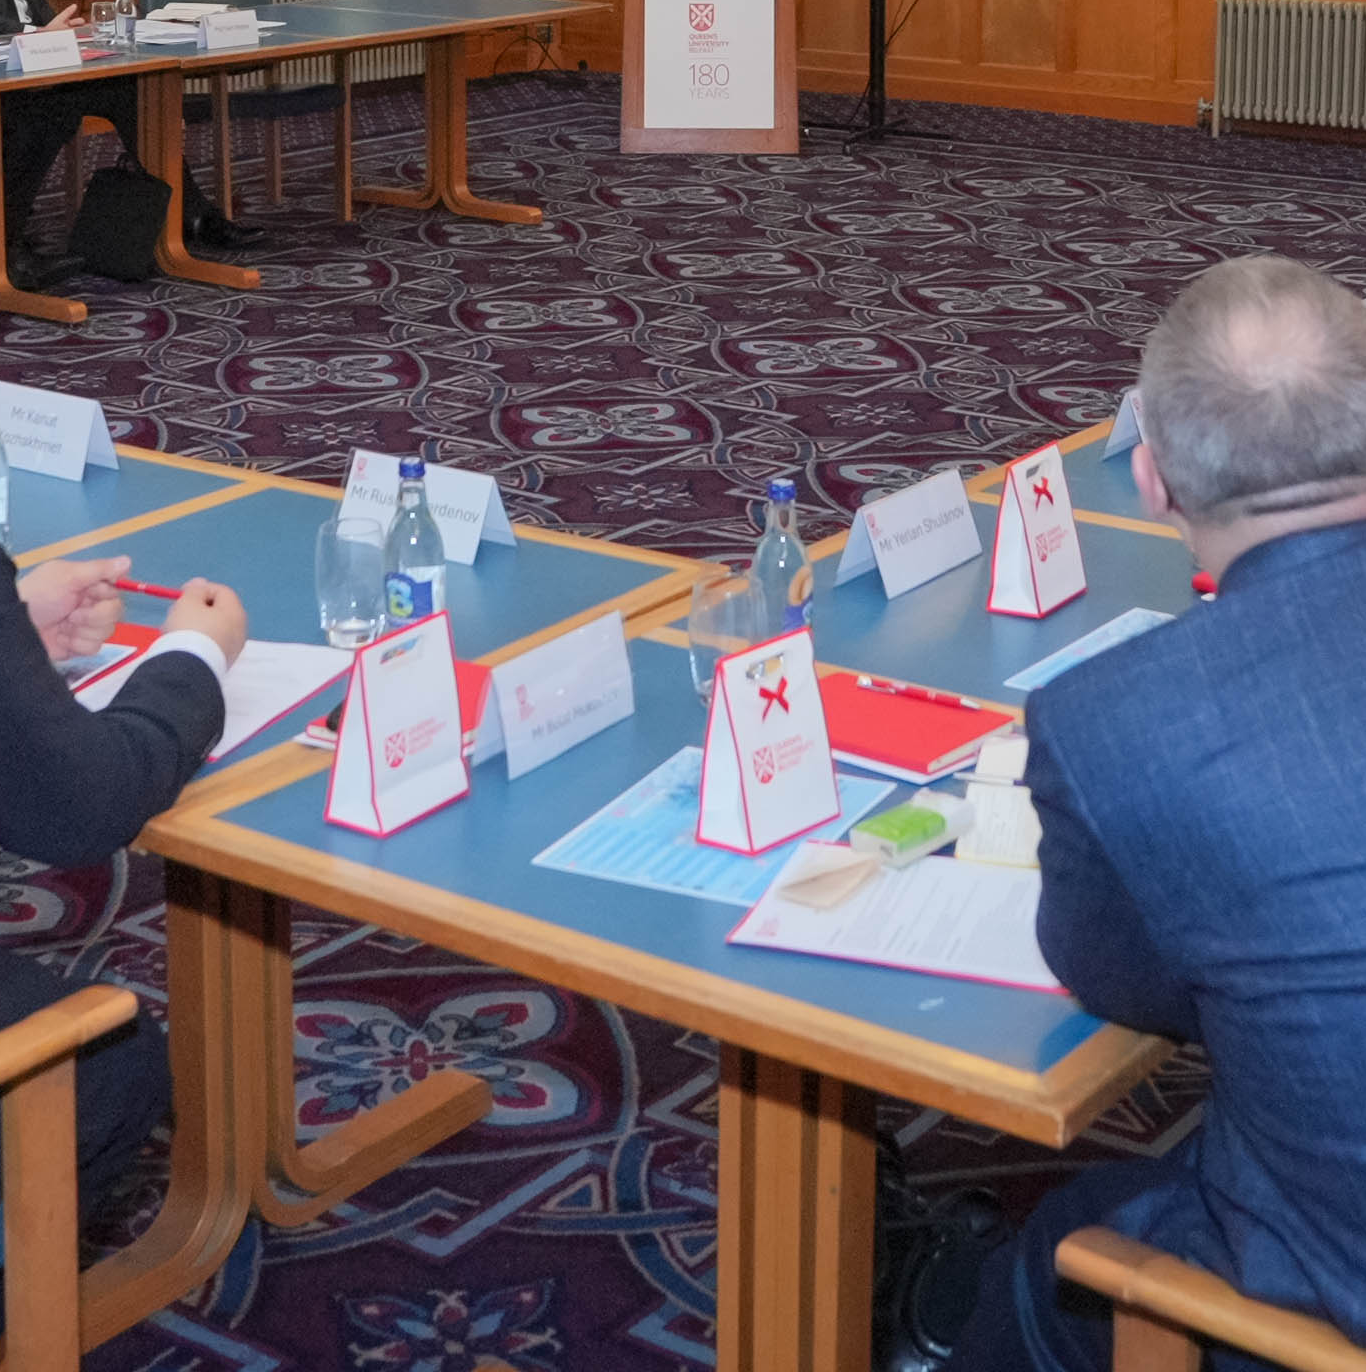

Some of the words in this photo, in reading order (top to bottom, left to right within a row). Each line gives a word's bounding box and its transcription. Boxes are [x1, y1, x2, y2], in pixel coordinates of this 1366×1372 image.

[689, 63, 729, 86] 180
[689, 87, 729, 100] YEARS
[350, 484, 367, 499] Mr
[879, 536, 893, 554] Mr
